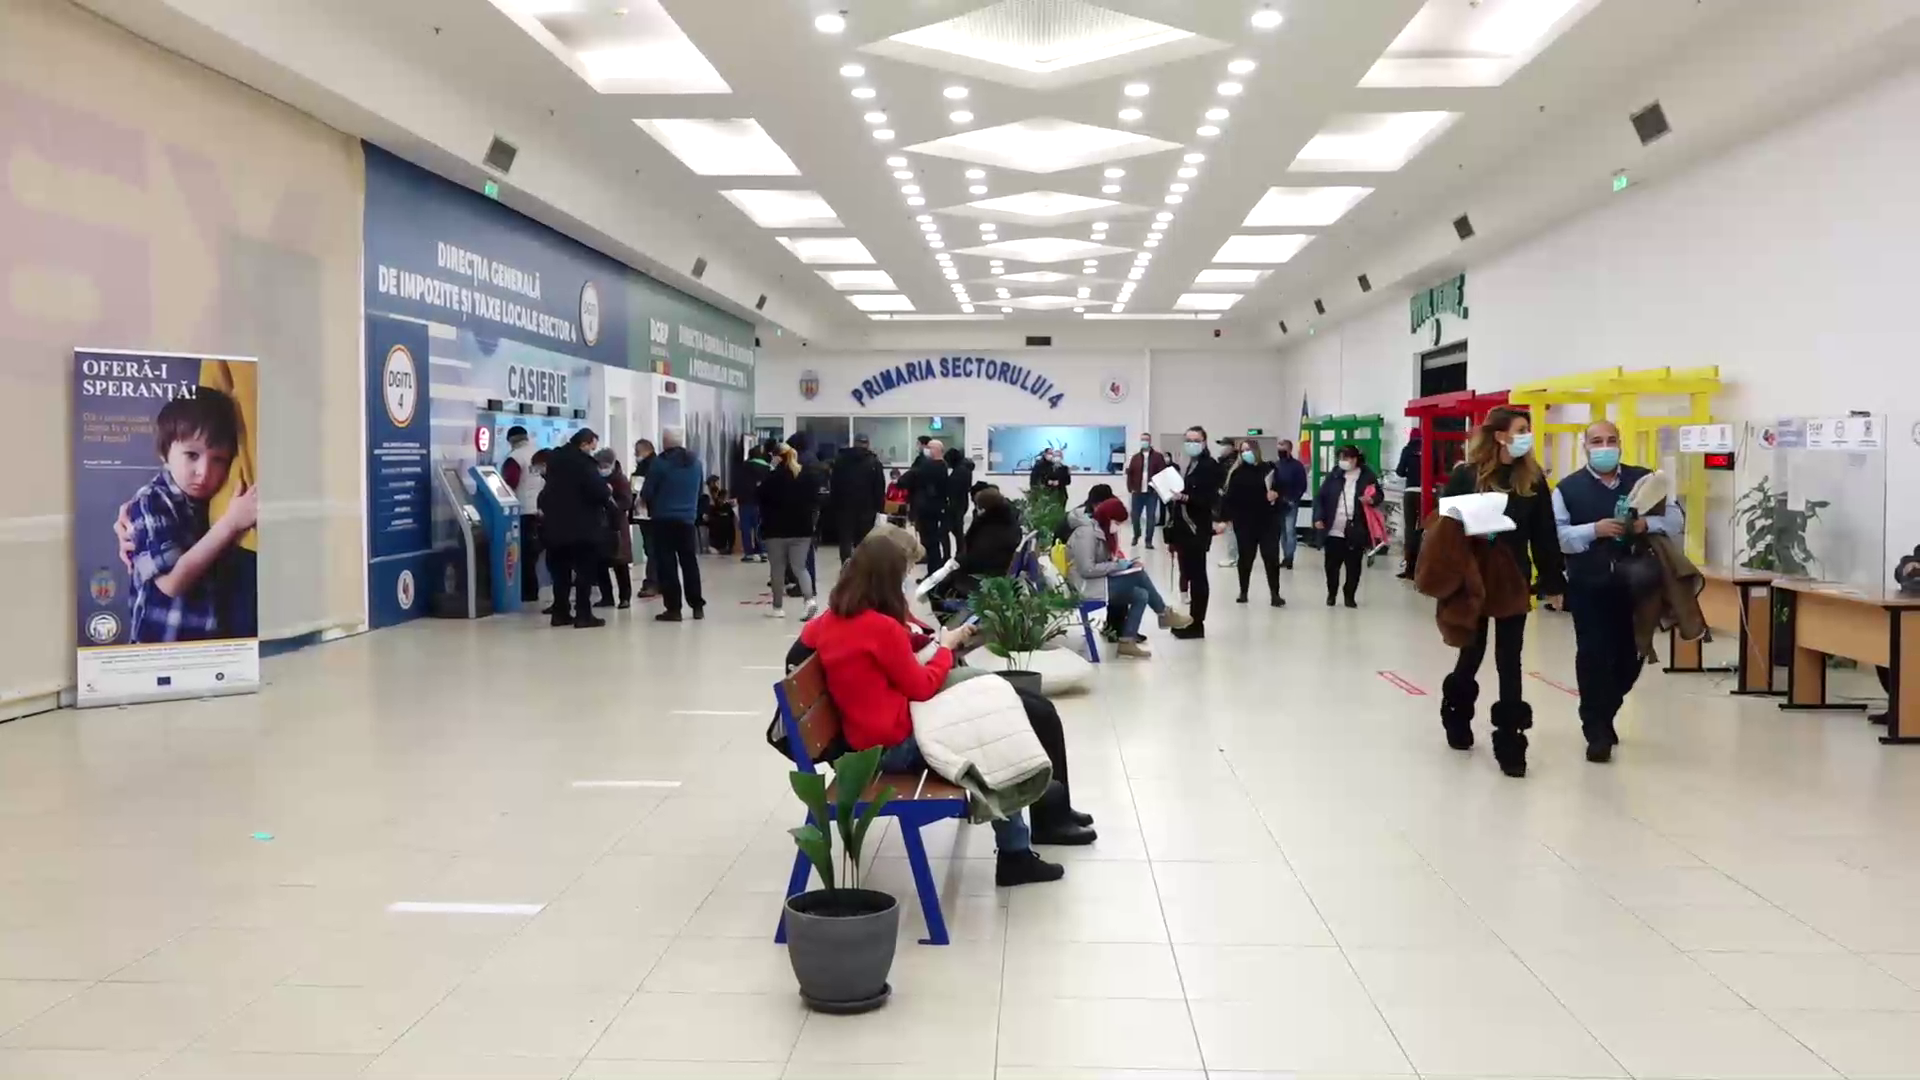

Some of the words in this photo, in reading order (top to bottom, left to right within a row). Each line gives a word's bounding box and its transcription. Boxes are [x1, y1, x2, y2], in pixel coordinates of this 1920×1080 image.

[437, 241, 490, 286] DIRECȚIA
[490, 261, 541, 300] GENERALĂ
[378, 264, 398, 295] DE
[399, 270, 460, 312] IMPOZITE
[473, 292, 501, 321] TAXE
[502, 301, 538, 333] LOCALE
[538, 313, 570, 342] SECTOR
[569, 324, 577, 343] 4
[83, 359, 168, 379] OFERĂ-I
[388, 371, 412, 389] DGITL
[851, 358, 936, 407] PRIMARIA
[939, 357, 1054, 400] SECTORULUI
[1047, 392, 1064, 409] 4
[83, 379, 197, 402] SPERANȚĂ!
[508, 365, 567, 405] CASIERIE
[397, 394, 404, 410] 4
